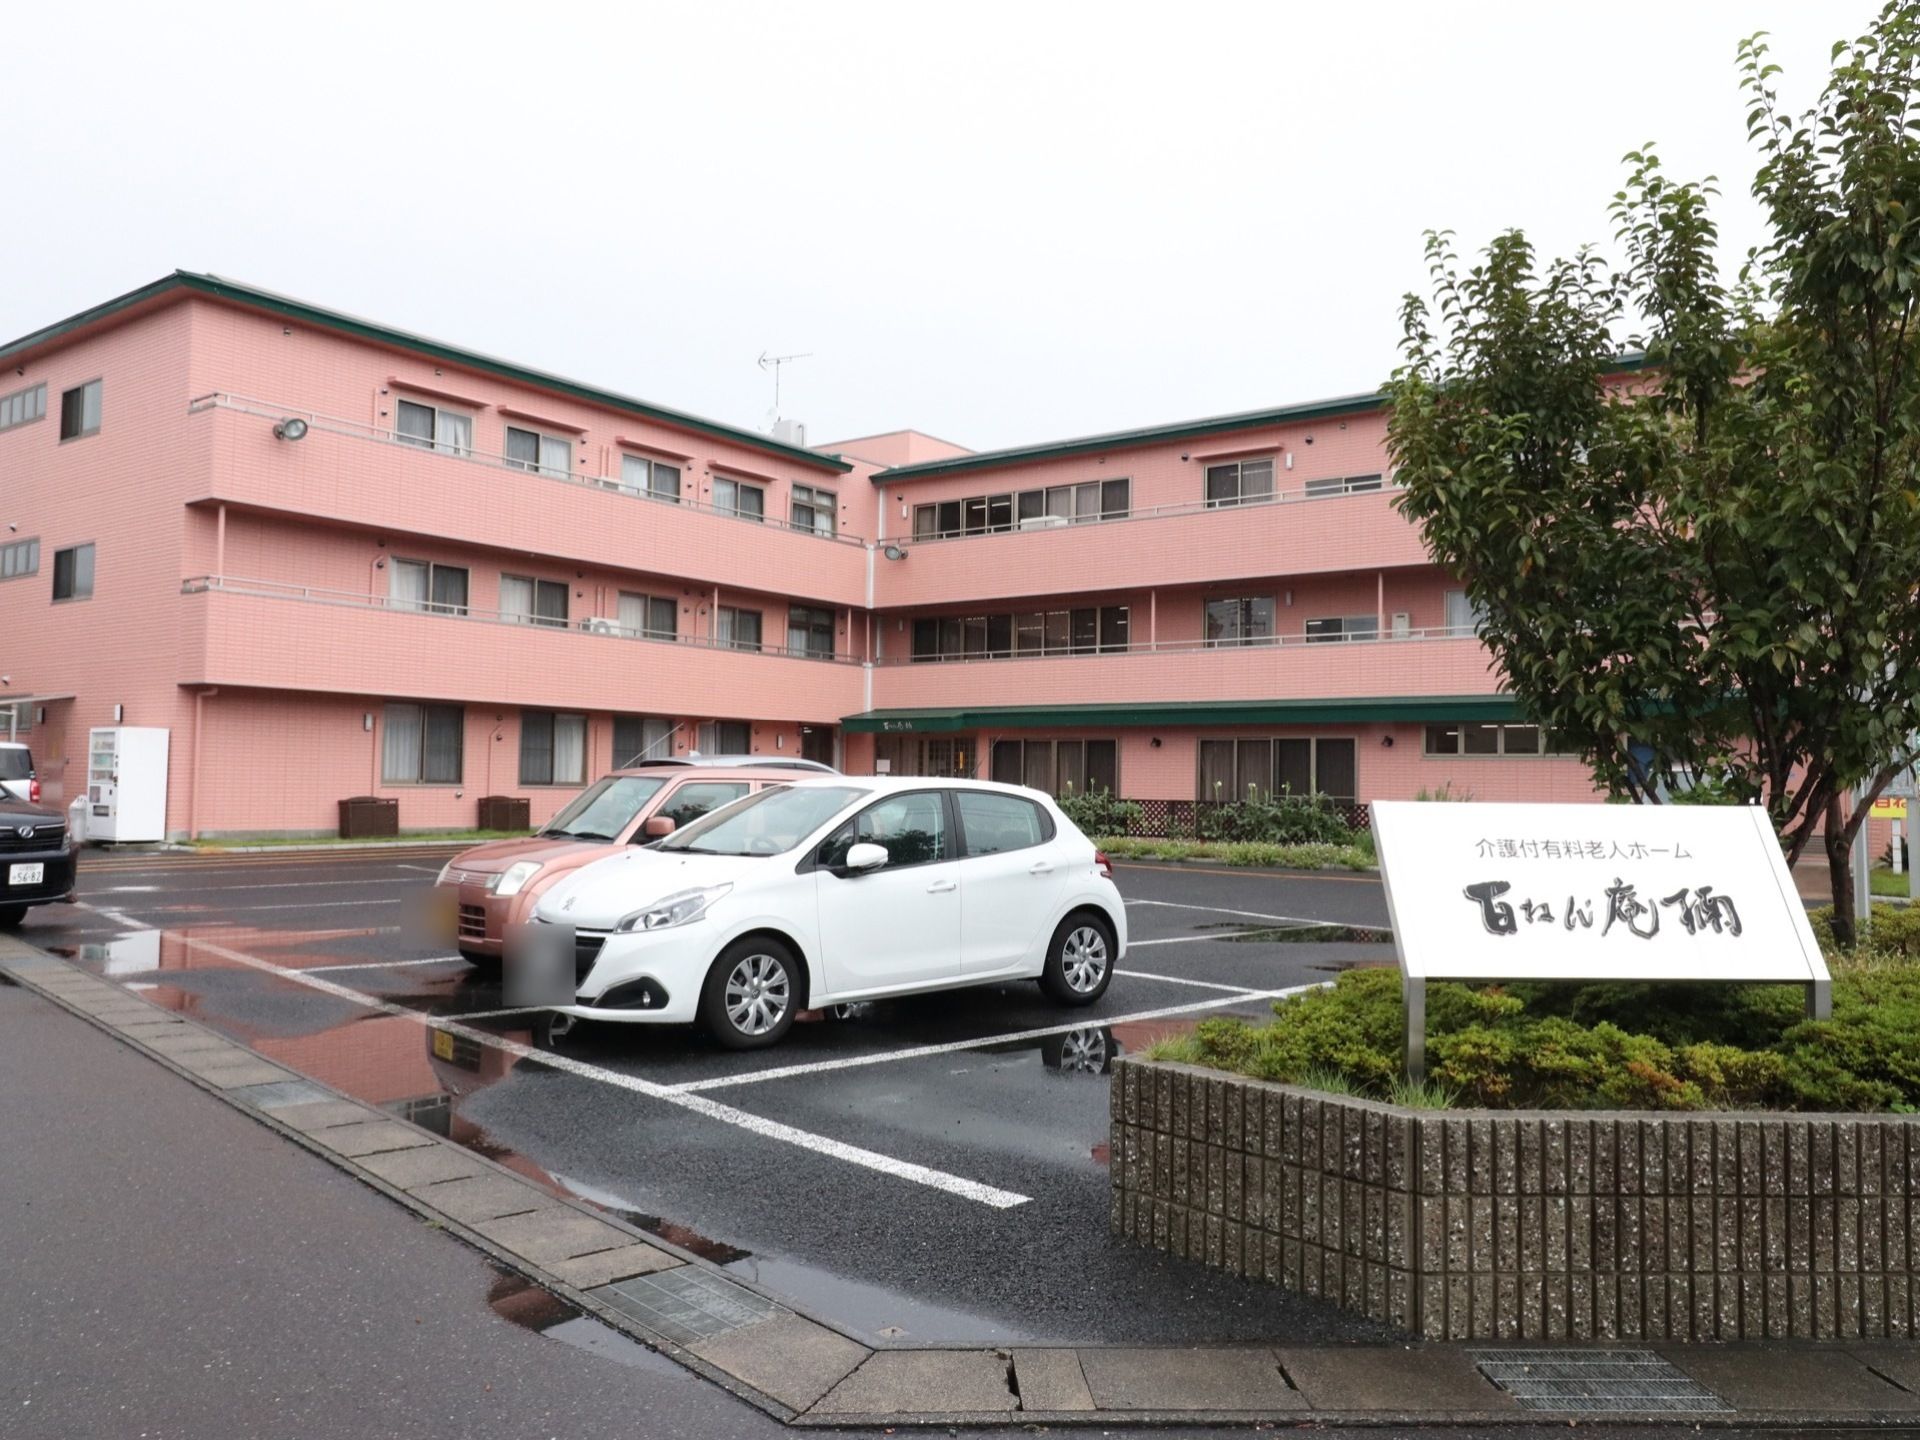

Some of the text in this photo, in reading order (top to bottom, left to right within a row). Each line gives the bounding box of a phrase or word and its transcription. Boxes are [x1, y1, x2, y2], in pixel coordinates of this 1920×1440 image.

[1475, 837, 1693, 860] 介護付有料老人ホーム
